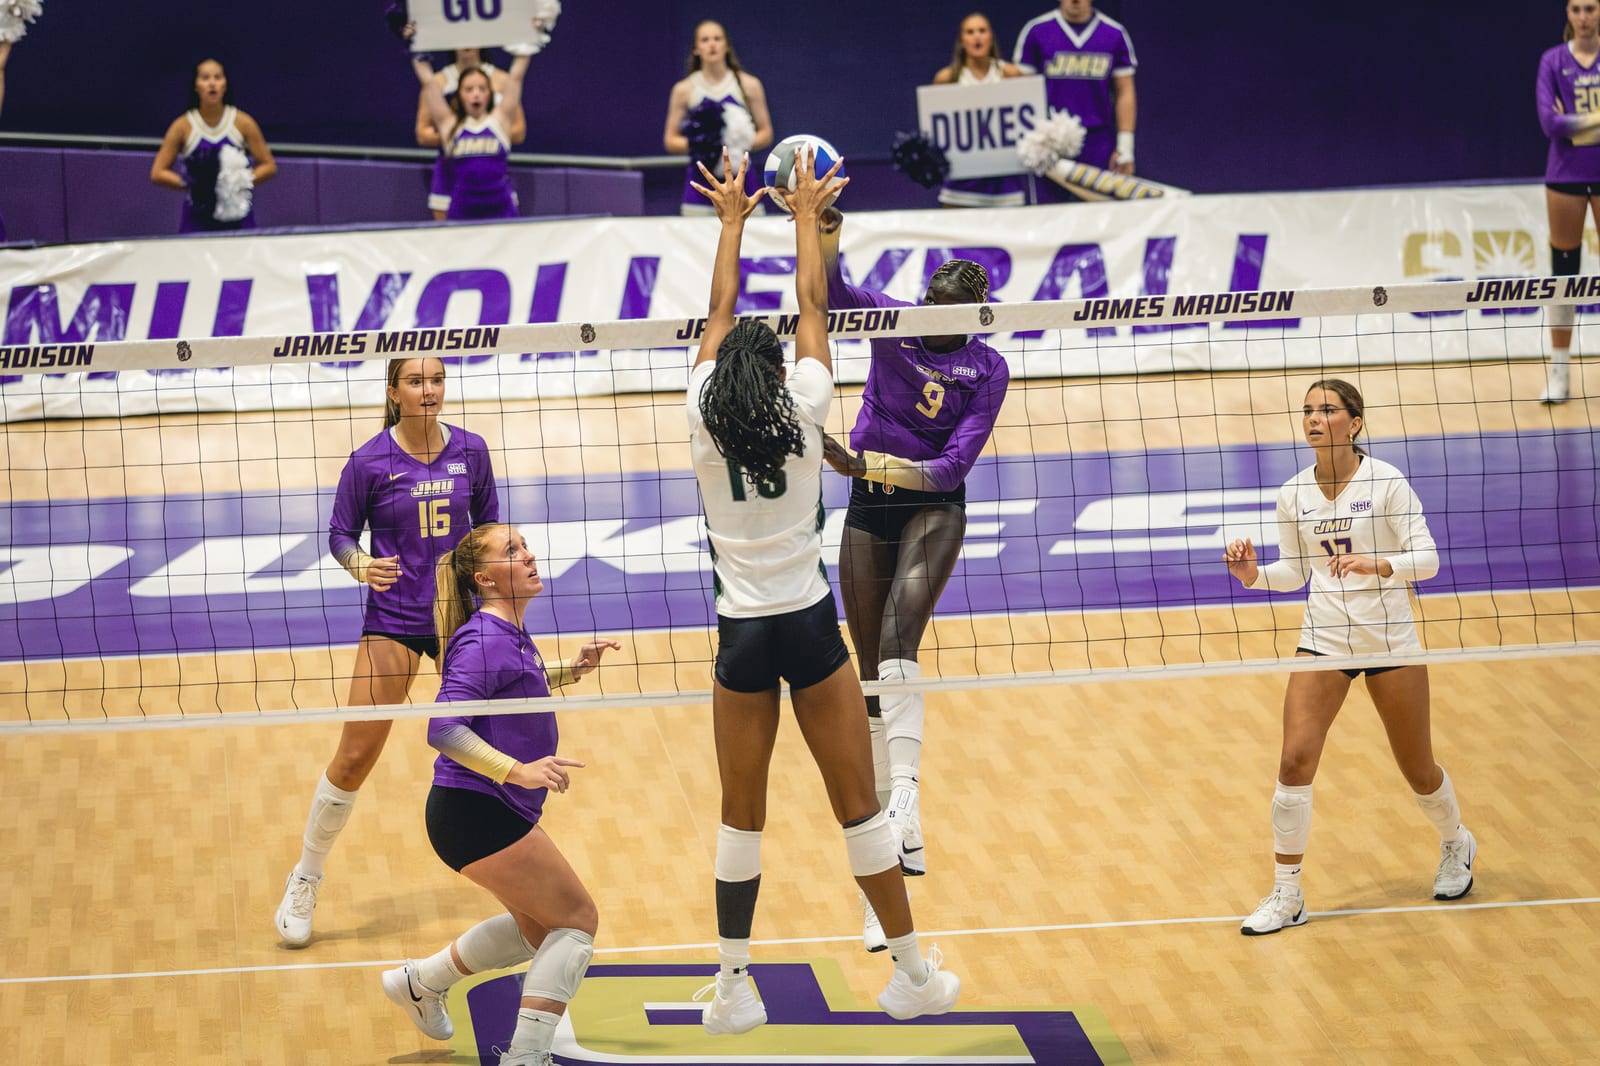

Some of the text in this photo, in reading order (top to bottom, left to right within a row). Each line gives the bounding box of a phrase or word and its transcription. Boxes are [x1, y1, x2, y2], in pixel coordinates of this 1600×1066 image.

[1045, 52, 1112, 80] JMU
[1574, 87, 1600, 113] 20
[930, 104, 1036, 152] DUKES
[1466, 278, 1557, 303] JAMES
[1073, 290, 1294, 321] JAMES MADISON
[777, 310, 900, 335] MDISON
[273, 327, 500, 358] JAMES MADISON
[915, 381, 945, 419] 9
[411, 479, 454, 497] JMU
[418, 498, 451, 538] 16
[1314, 517, 1352, 534] JMU
